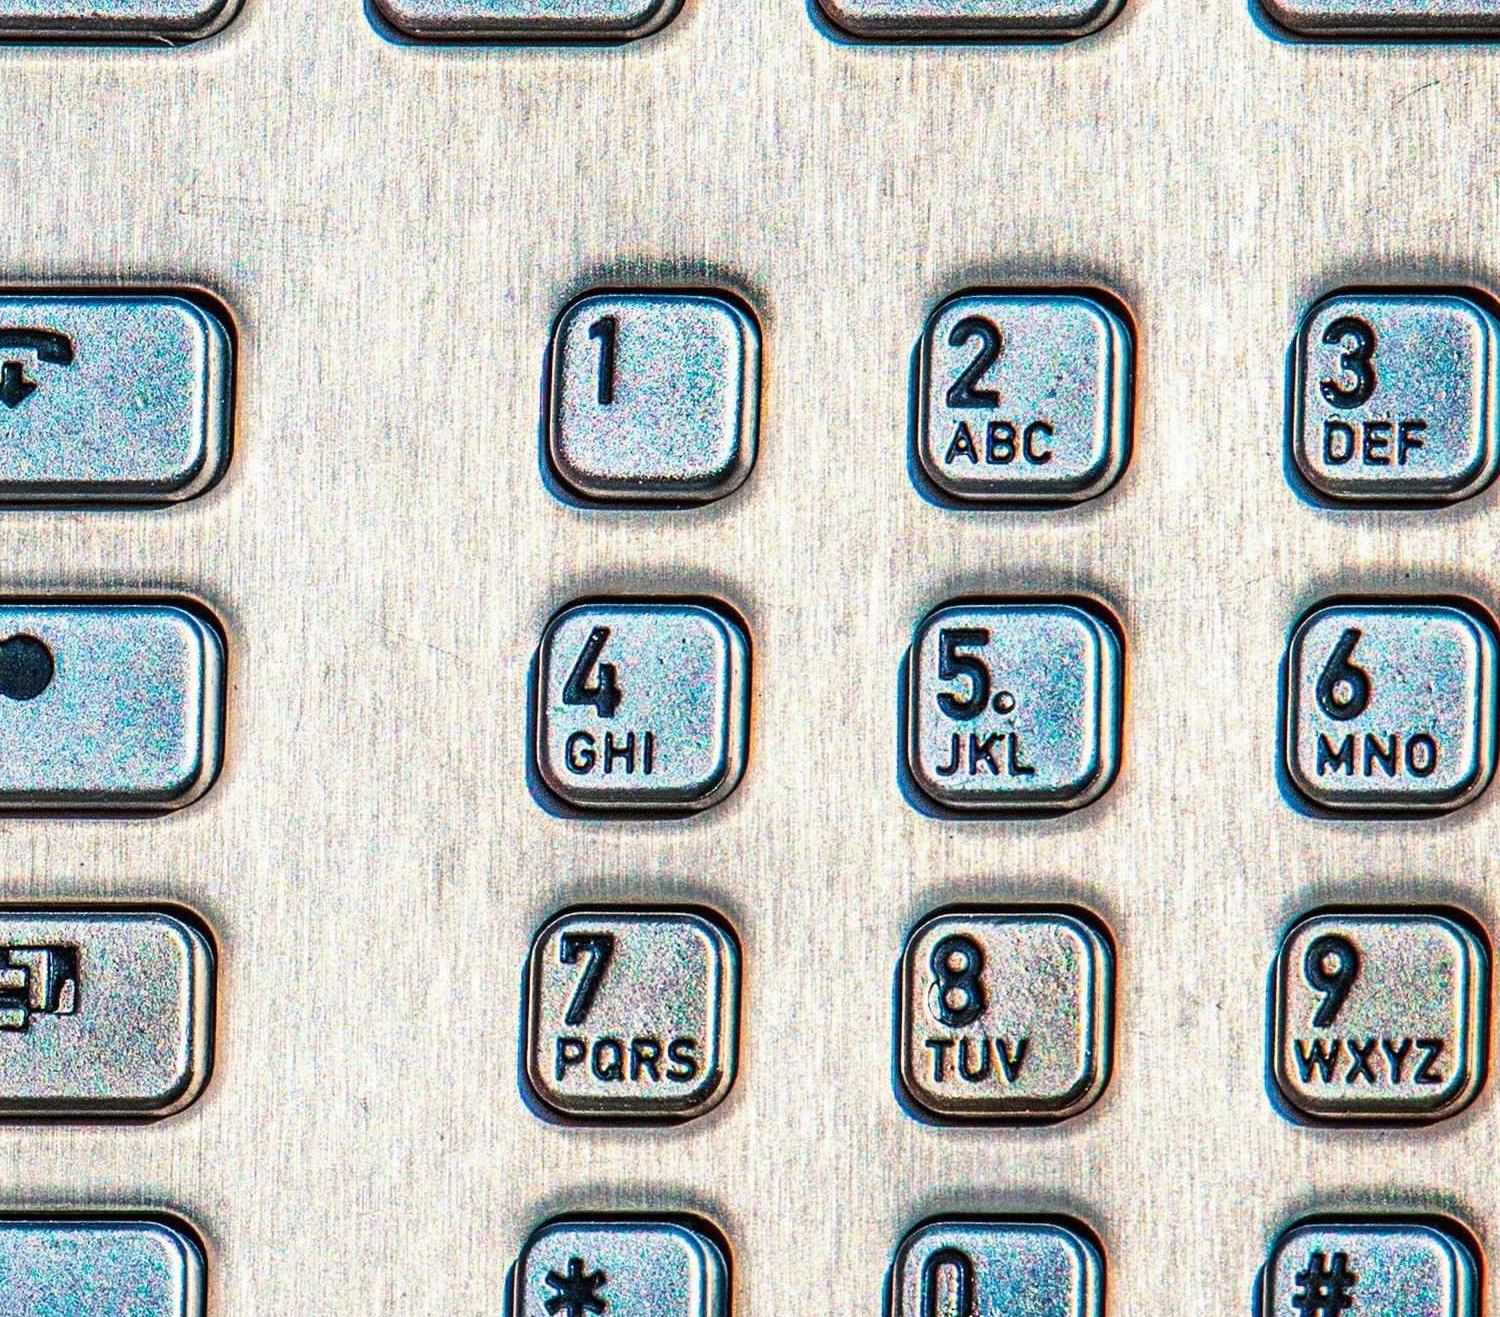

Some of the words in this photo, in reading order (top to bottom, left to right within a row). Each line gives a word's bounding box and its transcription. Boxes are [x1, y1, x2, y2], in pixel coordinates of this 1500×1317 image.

[588, 316, 616, 404] 1
[946, 315, 1001, 408] 2
[1320, 316, 1377, 409] 3
[945, 421, 1054, 465] ABC
[1323, 419, 1428, 466] DEF
[562, 626, 622, 718] 4
[1316, 627, 1371, 721] 6
[565, 731, 654, 775] GHI
[936, 732, 1036, 777] JKL
[1316, 733, 1437, 778] MNO
[559, 931, 614, 1026] 7
[928, 934, 988, 1028] 8
[1304, 935, 1359, 1028] 9
[555, 1037, 698, 1082] PQRS
[925, 1037, 1028, 1083] TUV
[1294, 1038, 1443, 1084] WXYZ
